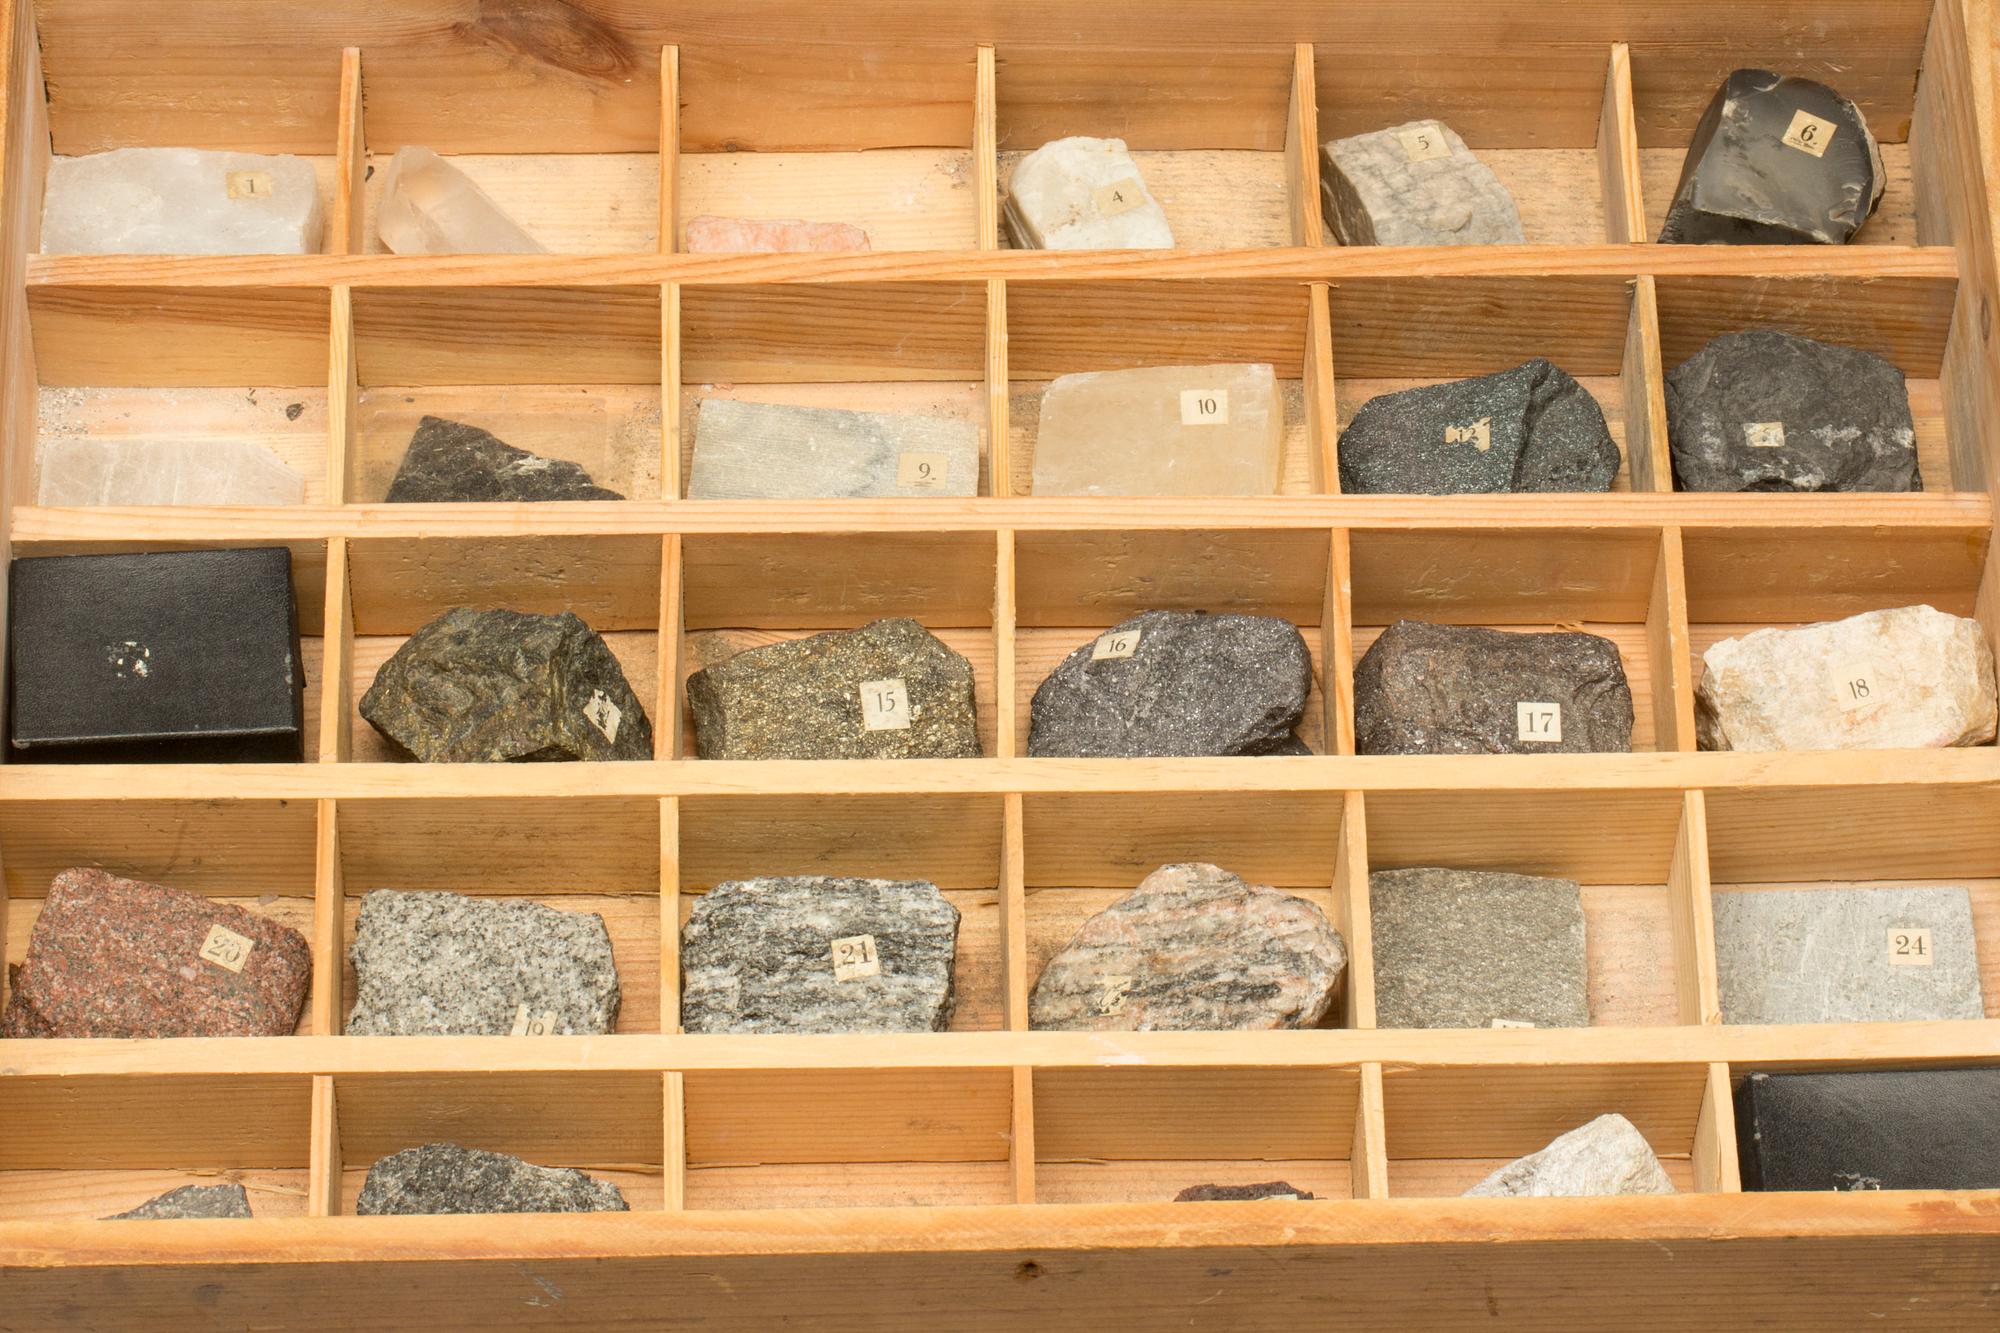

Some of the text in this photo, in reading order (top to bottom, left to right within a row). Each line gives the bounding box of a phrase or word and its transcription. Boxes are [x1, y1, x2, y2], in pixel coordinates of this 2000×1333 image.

[1417, 135, 1430, 151] 5
[245, 178, 255, 194] 1
[1112, 190, 1124, 203] 4
[1198, 398, 1217, 415] 10
[1109, 638, 1127, 653] 16
[1849, 678, 1870, 700] 18
[877, 691, 896, 713] 15
[1525, 712, 1554, 733] 17
[840, 941, 873, 965] 21
[1895, 934, 1927, 956] 24
